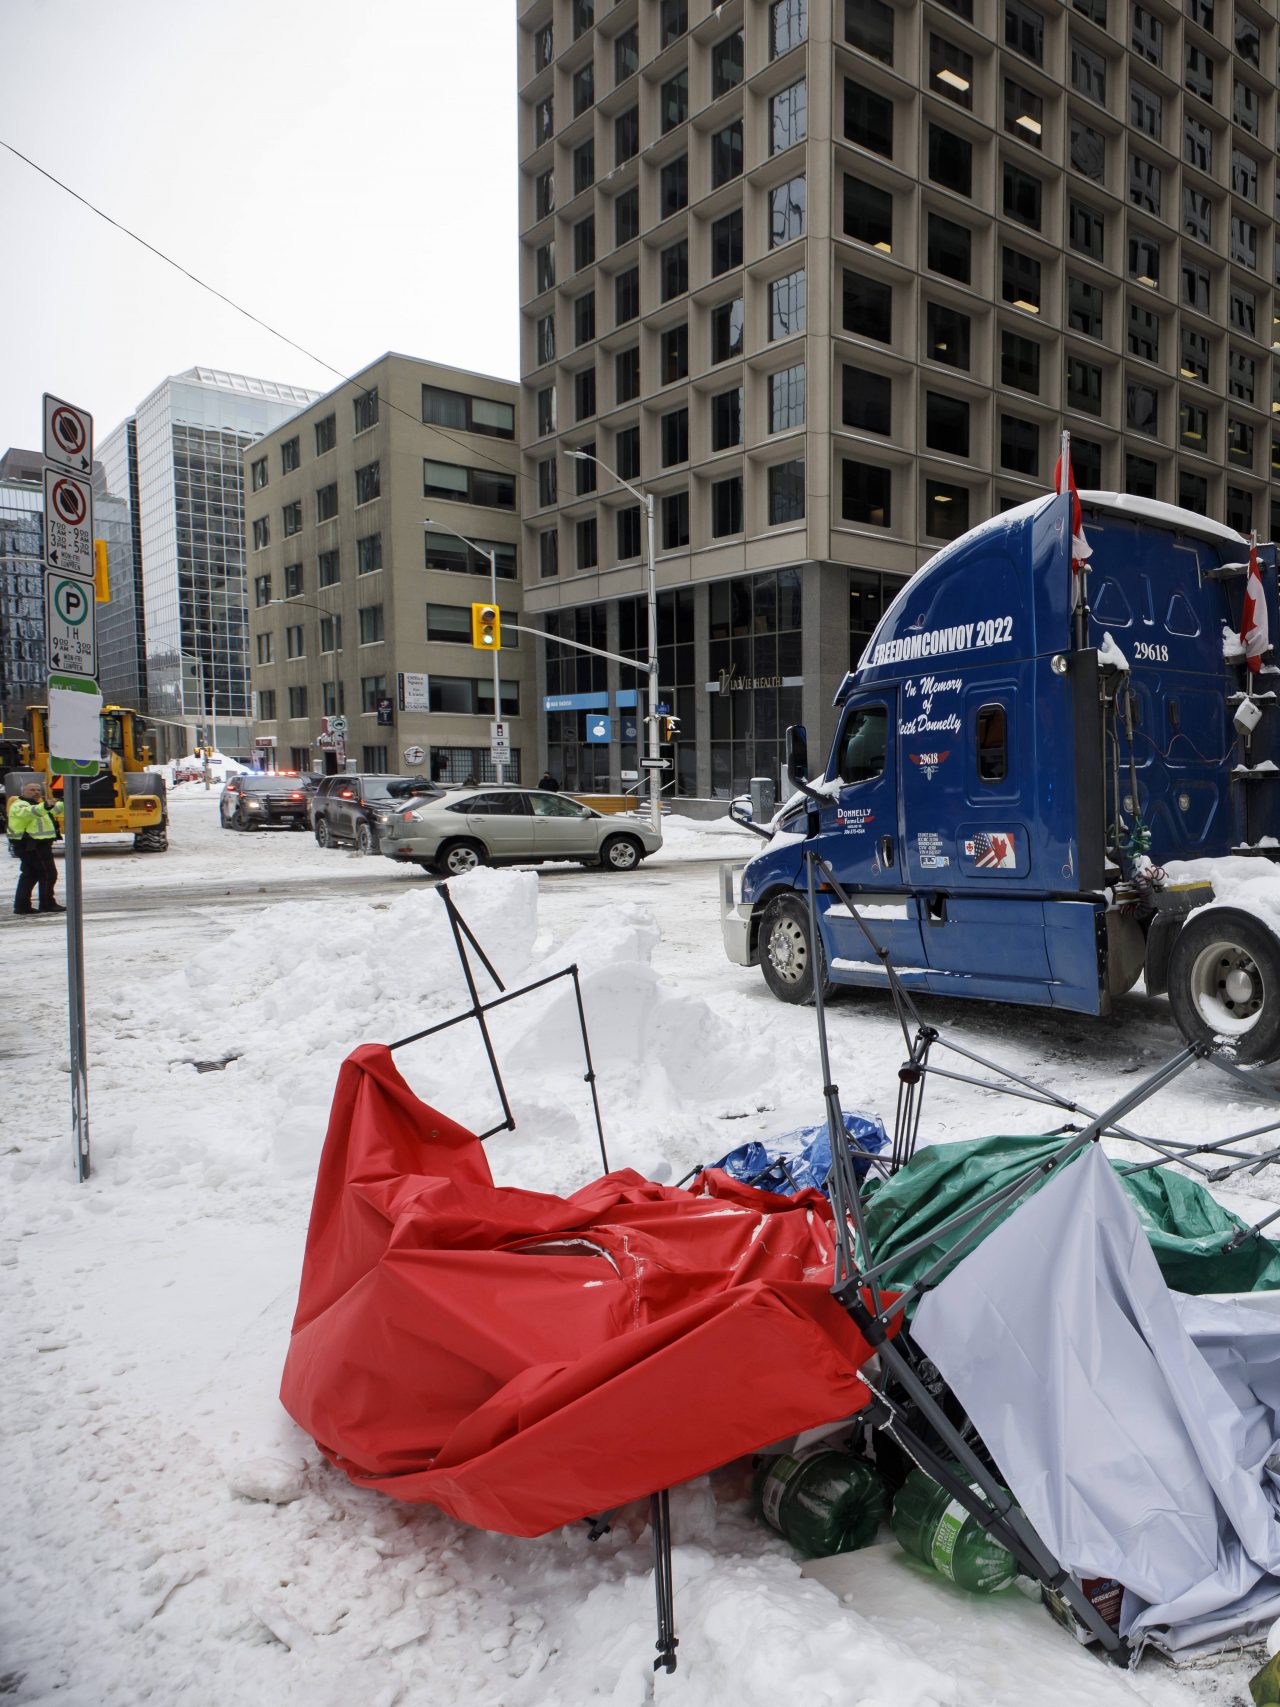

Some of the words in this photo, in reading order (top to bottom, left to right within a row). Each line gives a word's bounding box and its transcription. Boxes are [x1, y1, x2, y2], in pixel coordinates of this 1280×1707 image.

[873, 622, 975, 666] FREEDOMCONVOY
[976, 616, 1013, 646] 2022
[1133, 641, 1169, 662] 29618
[753, 676, 781, 689] HEALTH
[905, 680, 916, 698] In
[919, 676, 962, 694] Memory
[922, 694, 934, 715] of
[917, 712, 962, 734] Donnelly
[919, 752, 939, 765] 29618
